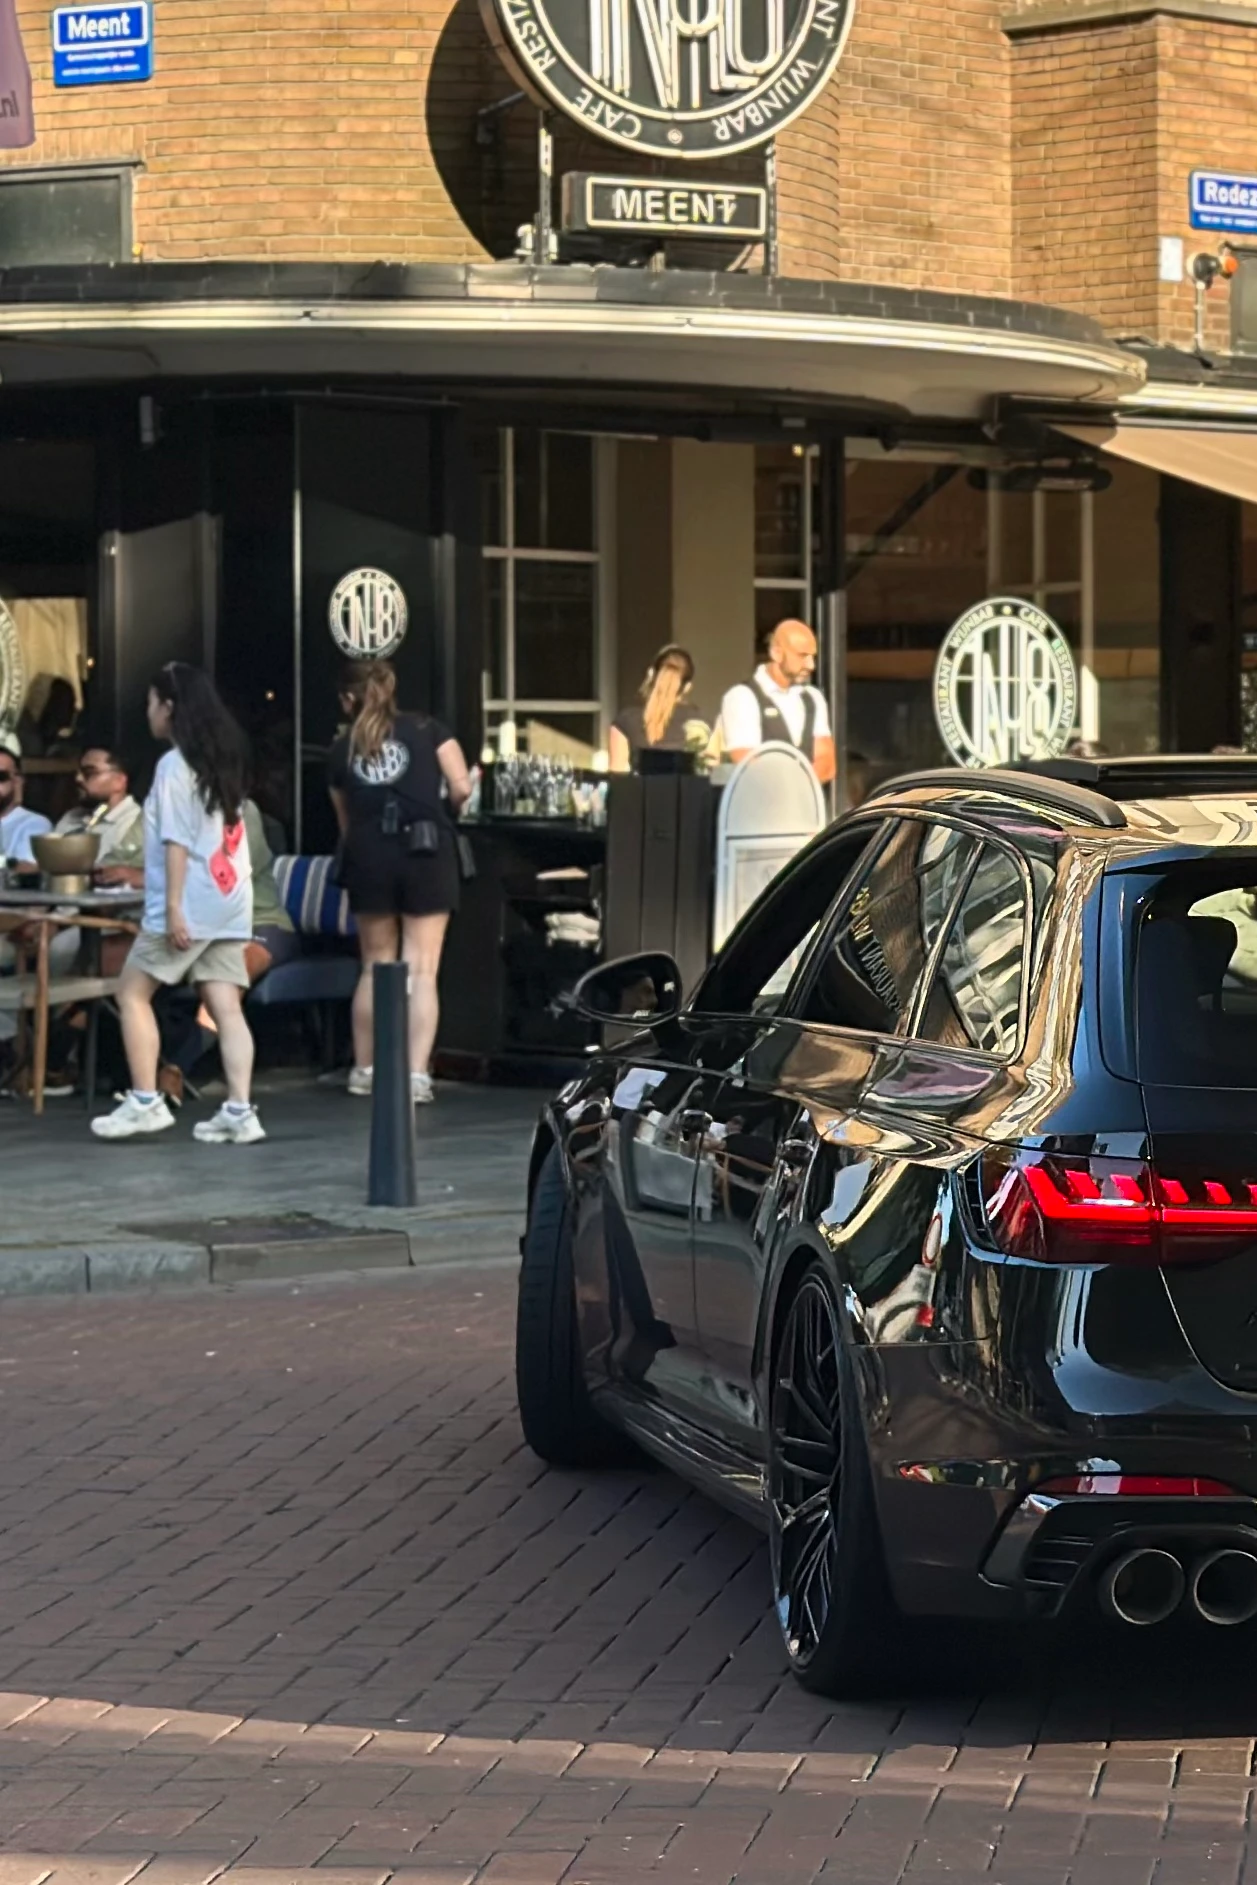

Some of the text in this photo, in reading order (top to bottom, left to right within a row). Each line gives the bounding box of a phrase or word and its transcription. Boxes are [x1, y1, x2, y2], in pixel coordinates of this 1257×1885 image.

[67, 11, 131, 40] Meent
[570, 87, 642, 139] CAFE
[711, 58, 818, 140] WIJNBAR
[613, 187, 737, 224] MEENT
[1018, 607, 1048, 633] CAFE
